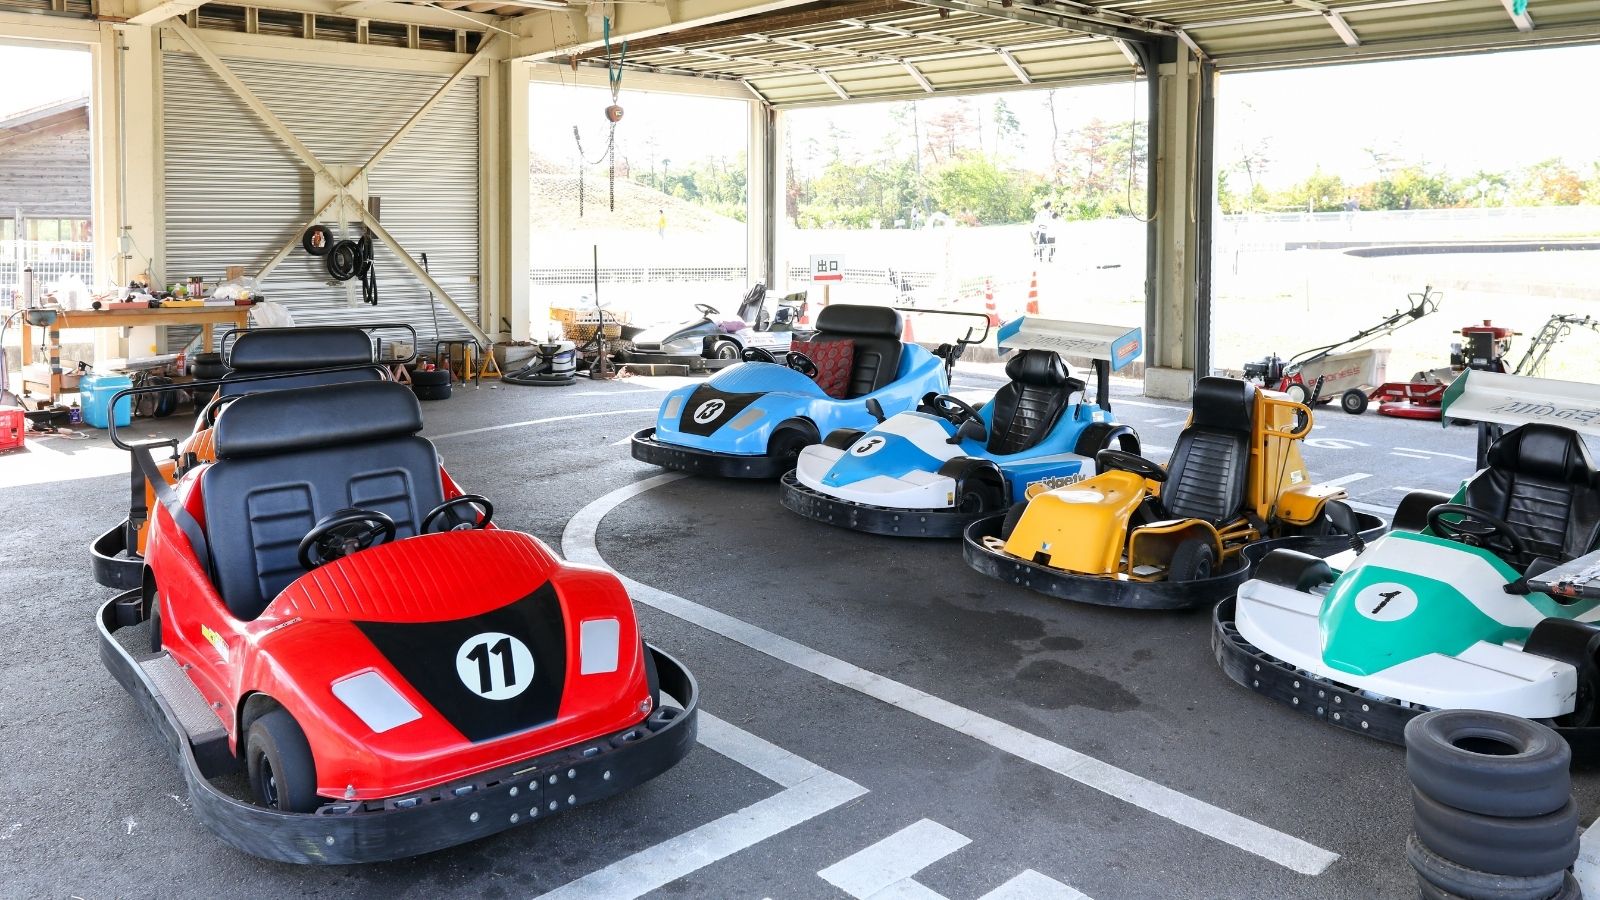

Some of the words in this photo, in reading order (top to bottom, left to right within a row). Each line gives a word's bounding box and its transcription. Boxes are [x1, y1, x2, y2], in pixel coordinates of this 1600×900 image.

[817, 259, 838, 272] 出口
[698, 400, 722, 419] 13
[858, 440, 881, 453] 3
[1372, 591, 1401, 614] 1
[466, 638, 514, 693] 11
